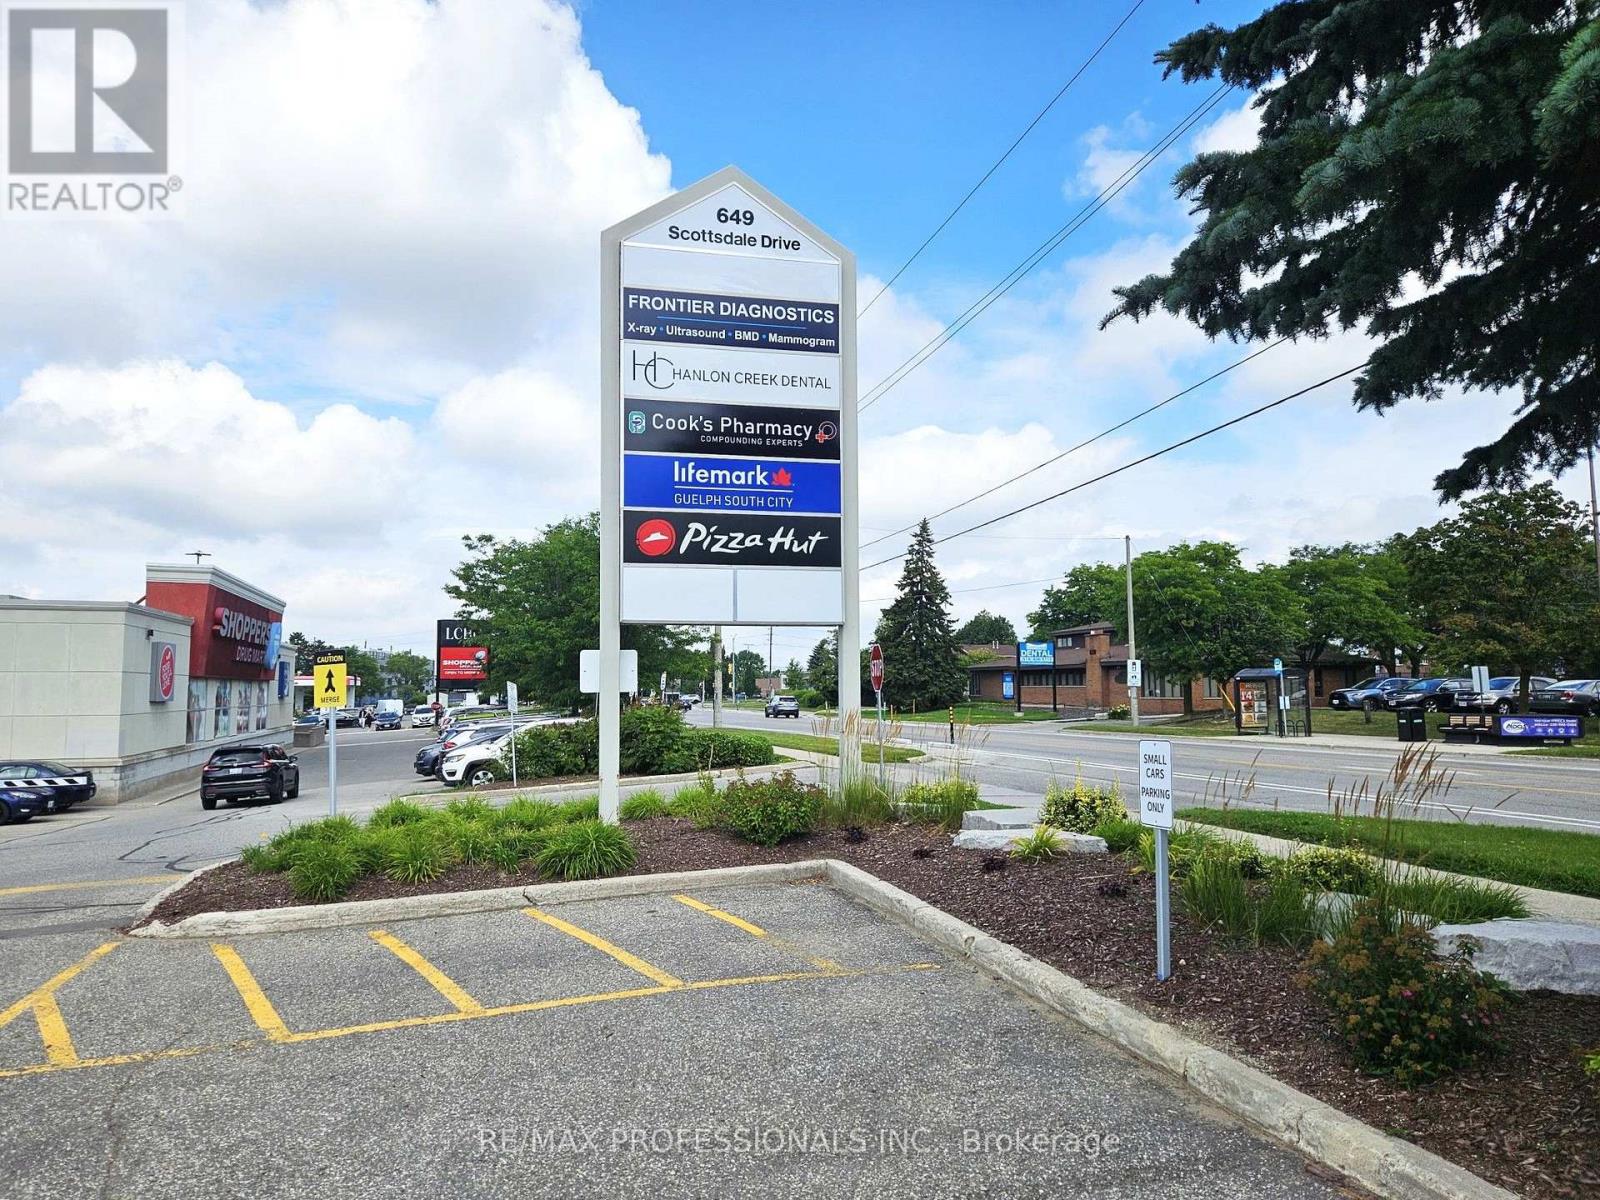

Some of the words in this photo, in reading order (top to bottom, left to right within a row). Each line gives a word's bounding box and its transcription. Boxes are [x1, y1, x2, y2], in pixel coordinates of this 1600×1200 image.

[716, 208, 755, 226] 649
[668, 226, 757, 247] Scottsdale
[761, 235, 801, 251] Drive
[628, 295, 715, 316] FRONTIER
[719, 302, 835, 324] DIAGNOSTICS
[627, 322, 657, 336] X-ray
[666, 325, 726, 340] Ultrasound
[734, 330, 760, 342] BMD
[768, 333, 836, 348] Mammogram
[672, 368, 730, 383] HANLON
[734, 371, 779, 386] CREEK
[781, 375, 832, 390] DENTAL
[652, 413, 713, 433] Cook's
[720, 417, 813, 441] Pharmacy
[700, 435, 763, 446] COMPOUNDING
[766, 438, 803, 447] EXPERTS
[674, 461, 769, 486] lifemark
[674, 493, 722, 506] GUELPH
[724, 496, 764, 507] SOUTH
[767, 497, 794, 508] CITY
[679, 522, 764, 555] Pizza
[767, 526, 830, 555] Hut
[219, 607, 271, 645] SHOPPERS
[317, 655, 344, 663] CAUTION
[1020, 649, 1053, 657] DENTAL
[871, 659, 882, 678] STOP
[1143, 754, 1167, 766] SMALL
[1146, 768, 1165, 780] CARS
[1141, 787, 1171, 800] PARKING
[1147, 801, 1165, 814] ONLY
